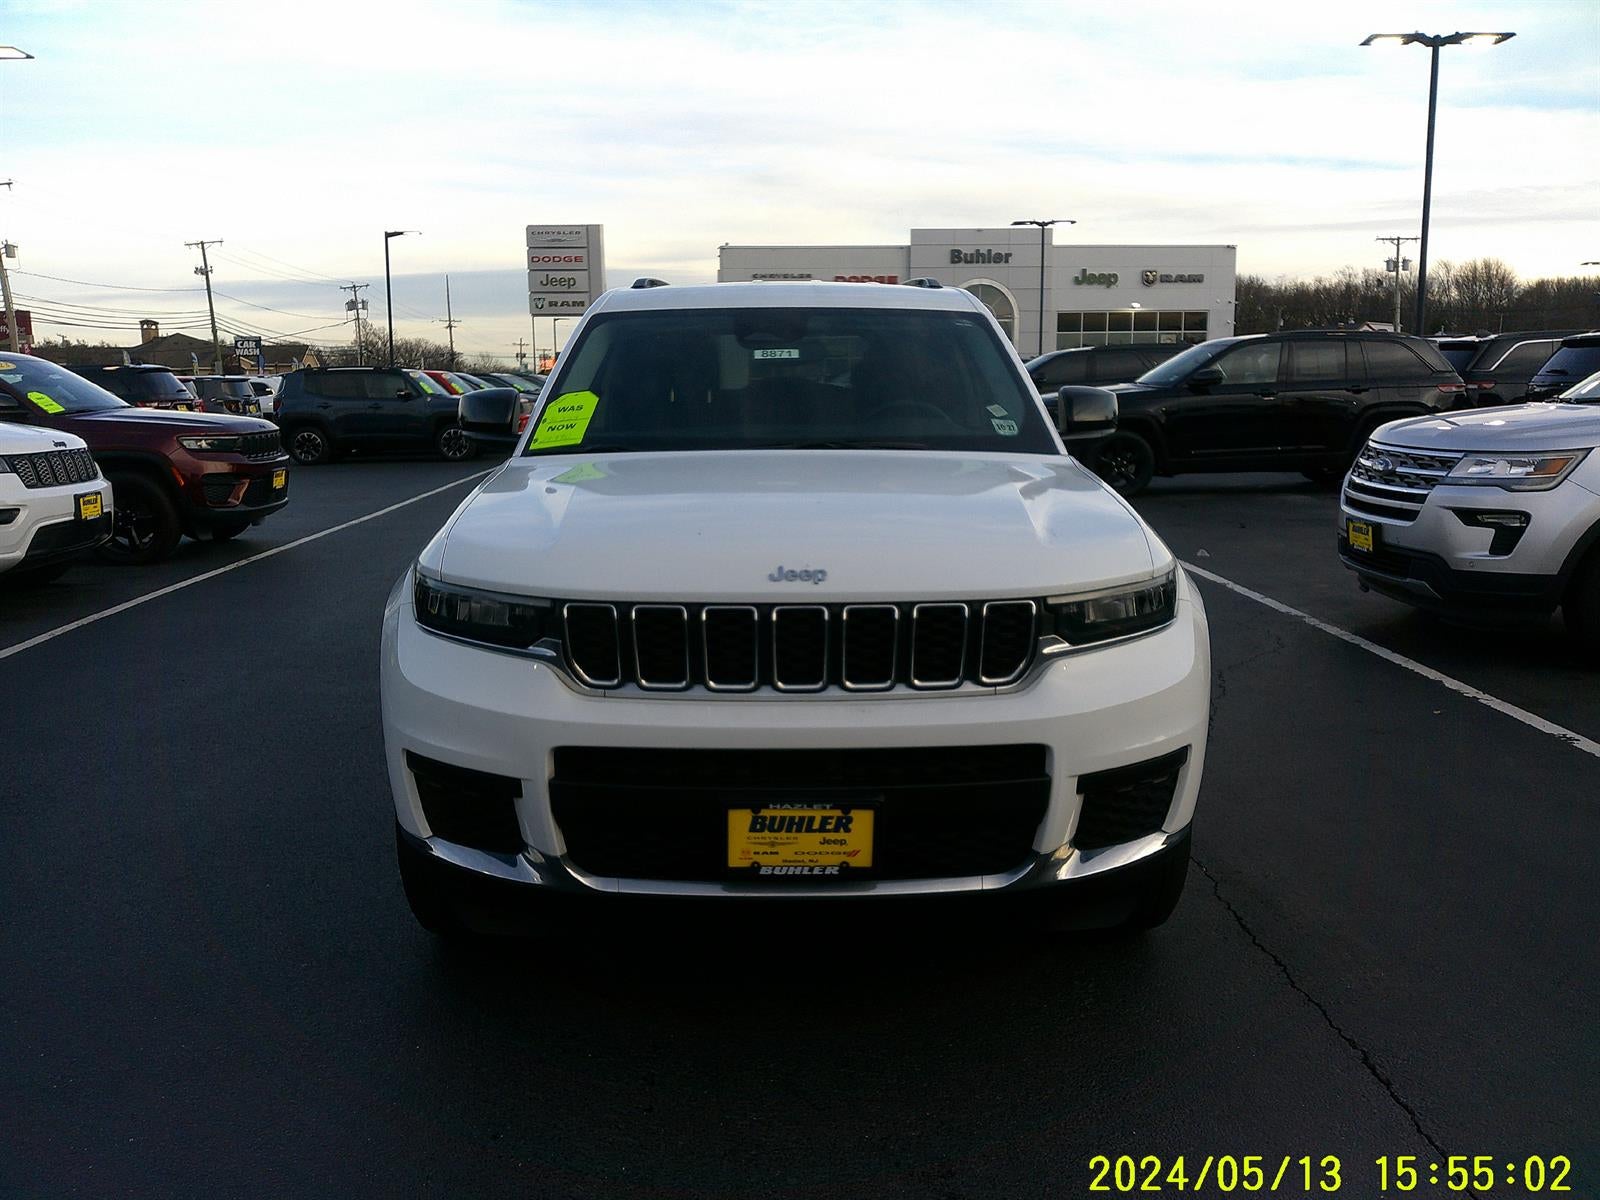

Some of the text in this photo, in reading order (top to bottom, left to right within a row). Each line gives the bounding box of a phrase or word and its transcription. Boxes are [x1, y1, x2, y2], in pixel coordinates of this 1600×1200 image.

[950, 249, 1012, 265] Buhler
[540, 274, 576, 289] Jeep
[1074, 268, 1119, 288] Jeep
[1159, 274, 1204, 284] RAM
[237, 341, 256, 349] CAR
[235, 348, 260, 356] WASH
[761, 350, 792, 358] 8871
[557, 404, 584, 413] WAS
[546, 423, 577, 432] NOW
[768, 565, 827, 585] Jeep
[748, 815, 854, 833] BUHLER
[819, 837, 848, 846] Jeep
[759, 866, 840, 875] BUHLER
